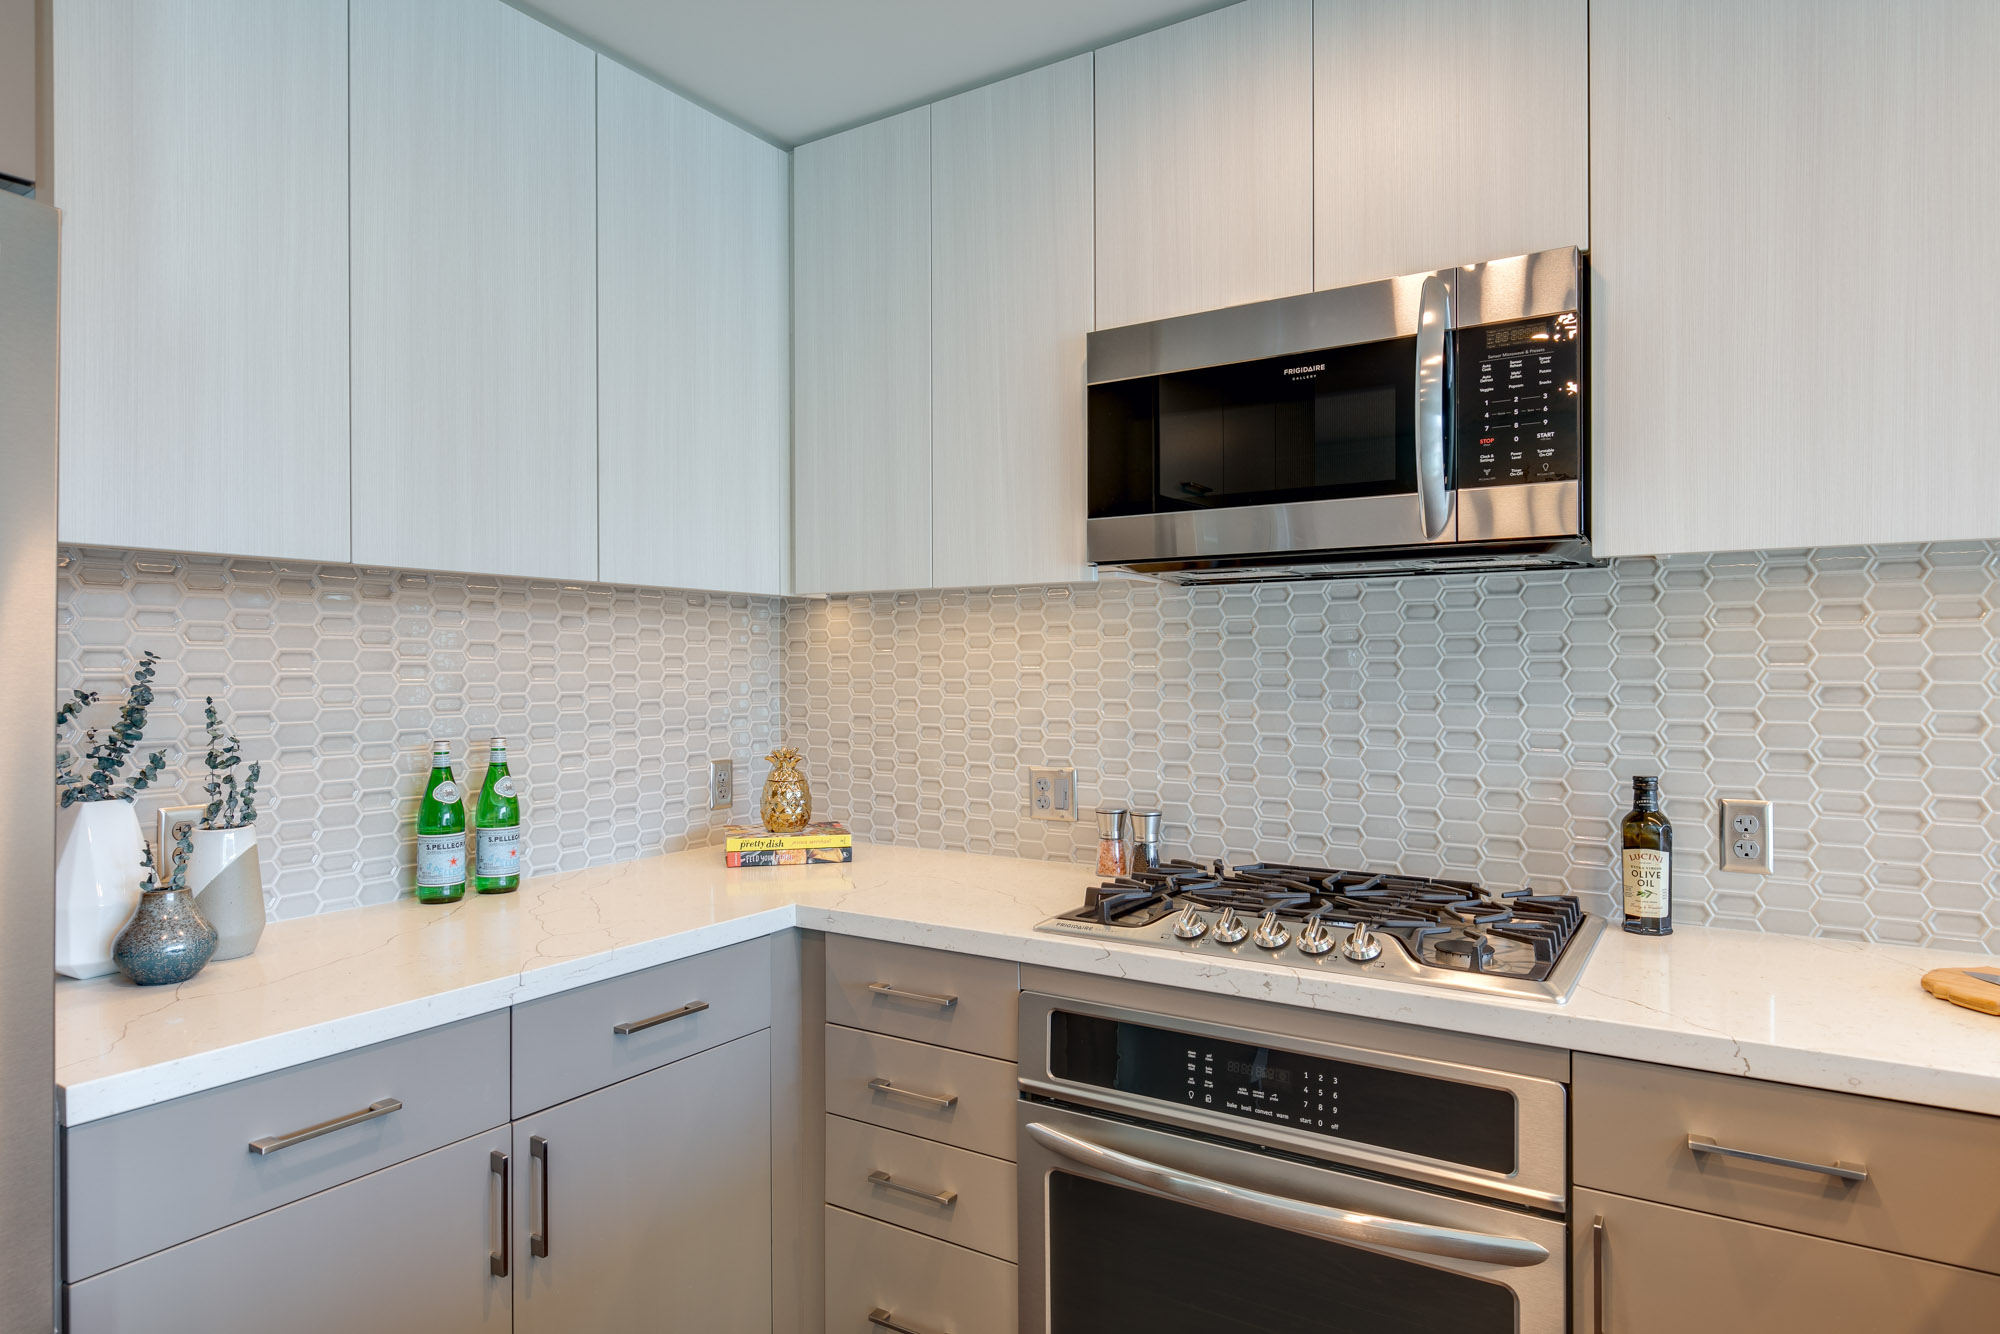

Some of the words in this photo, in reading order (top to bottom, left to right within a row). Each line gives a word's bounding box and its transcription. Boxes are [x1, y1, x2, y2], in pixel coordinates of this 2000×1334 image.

[1284, 364, 1326, 375] FRIGIDAIRE
[1543, 418, 1548, 426] 9
[1536, 431, 1555, 439] START
[1479, 437, 1495, 445] STOP
[739, 840, 766, 850] pretty
[765, 839, 785, 848] dish
[1632, 870, 1661, 879] OLIVE
[1638, 879, 1654, 887] OIL
[1056, 922, 1094, 930] FRIGIDAIRE
[1304, 1071, 1308, 1079] 1
[1318, 1074, 1324, 1082] 2
[1226, 1101, 1238, 1109] bake
[1240, 1104, 1252, 1112] broil
[1254, 1108, 1273, 1117] convect
[1275, 1112, 1290, 1120] warm
